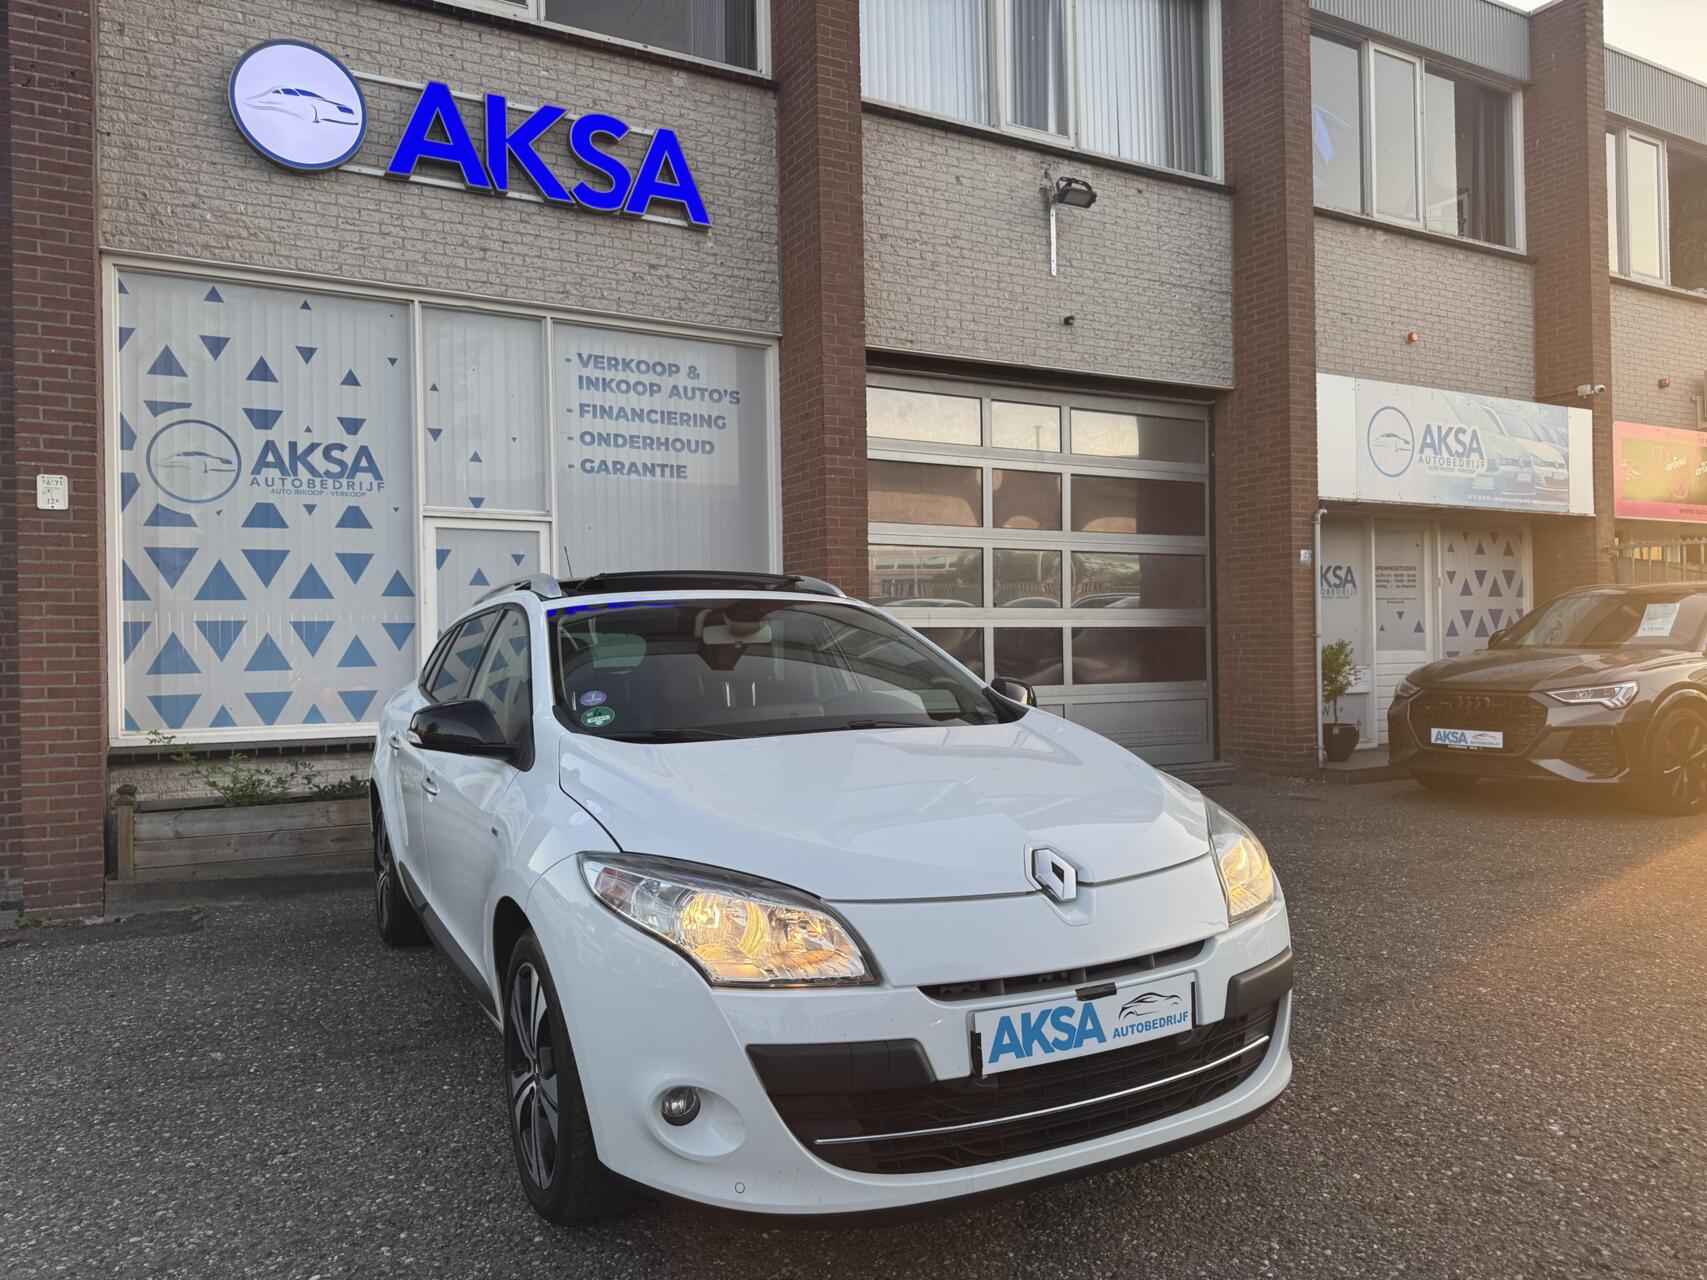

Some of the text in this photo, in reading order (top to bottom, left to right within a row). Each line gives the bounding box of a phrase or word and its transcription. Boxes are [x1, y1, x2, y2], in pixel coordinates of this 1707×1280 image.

[386, 80, 711, 226] AKSA
[577, 353, 680, 377] VERKOOP
[687, 365, 700, 380] &
[578, 375, 741, 405] INKOOP AUTO'S
[579, 403, 727, 430] FINANCIERING
[579, 431, 715, 455] ONDERHOUD
[1418, 424, 1485, 460] AKSA
[250, 440, 384, 481] AKSA
[580, 458, 688, 480] GARANTIE
[1418, 456, 1487, 469] AUTOBEDRIJF
[250, 476, 385, 493] AUTOBEDRIJF
[271, 488, 293, 496] AUTO
[294, 489, 324, 497] INKOOP
[331, 490, 366, 498] VERKOOP
[1320, 565, 1357, 589] KSA
[1434, 730, 1468, 744] AKSA
[988, 1002, 1189, 1064] AKSA AUTOBEDRIJF
